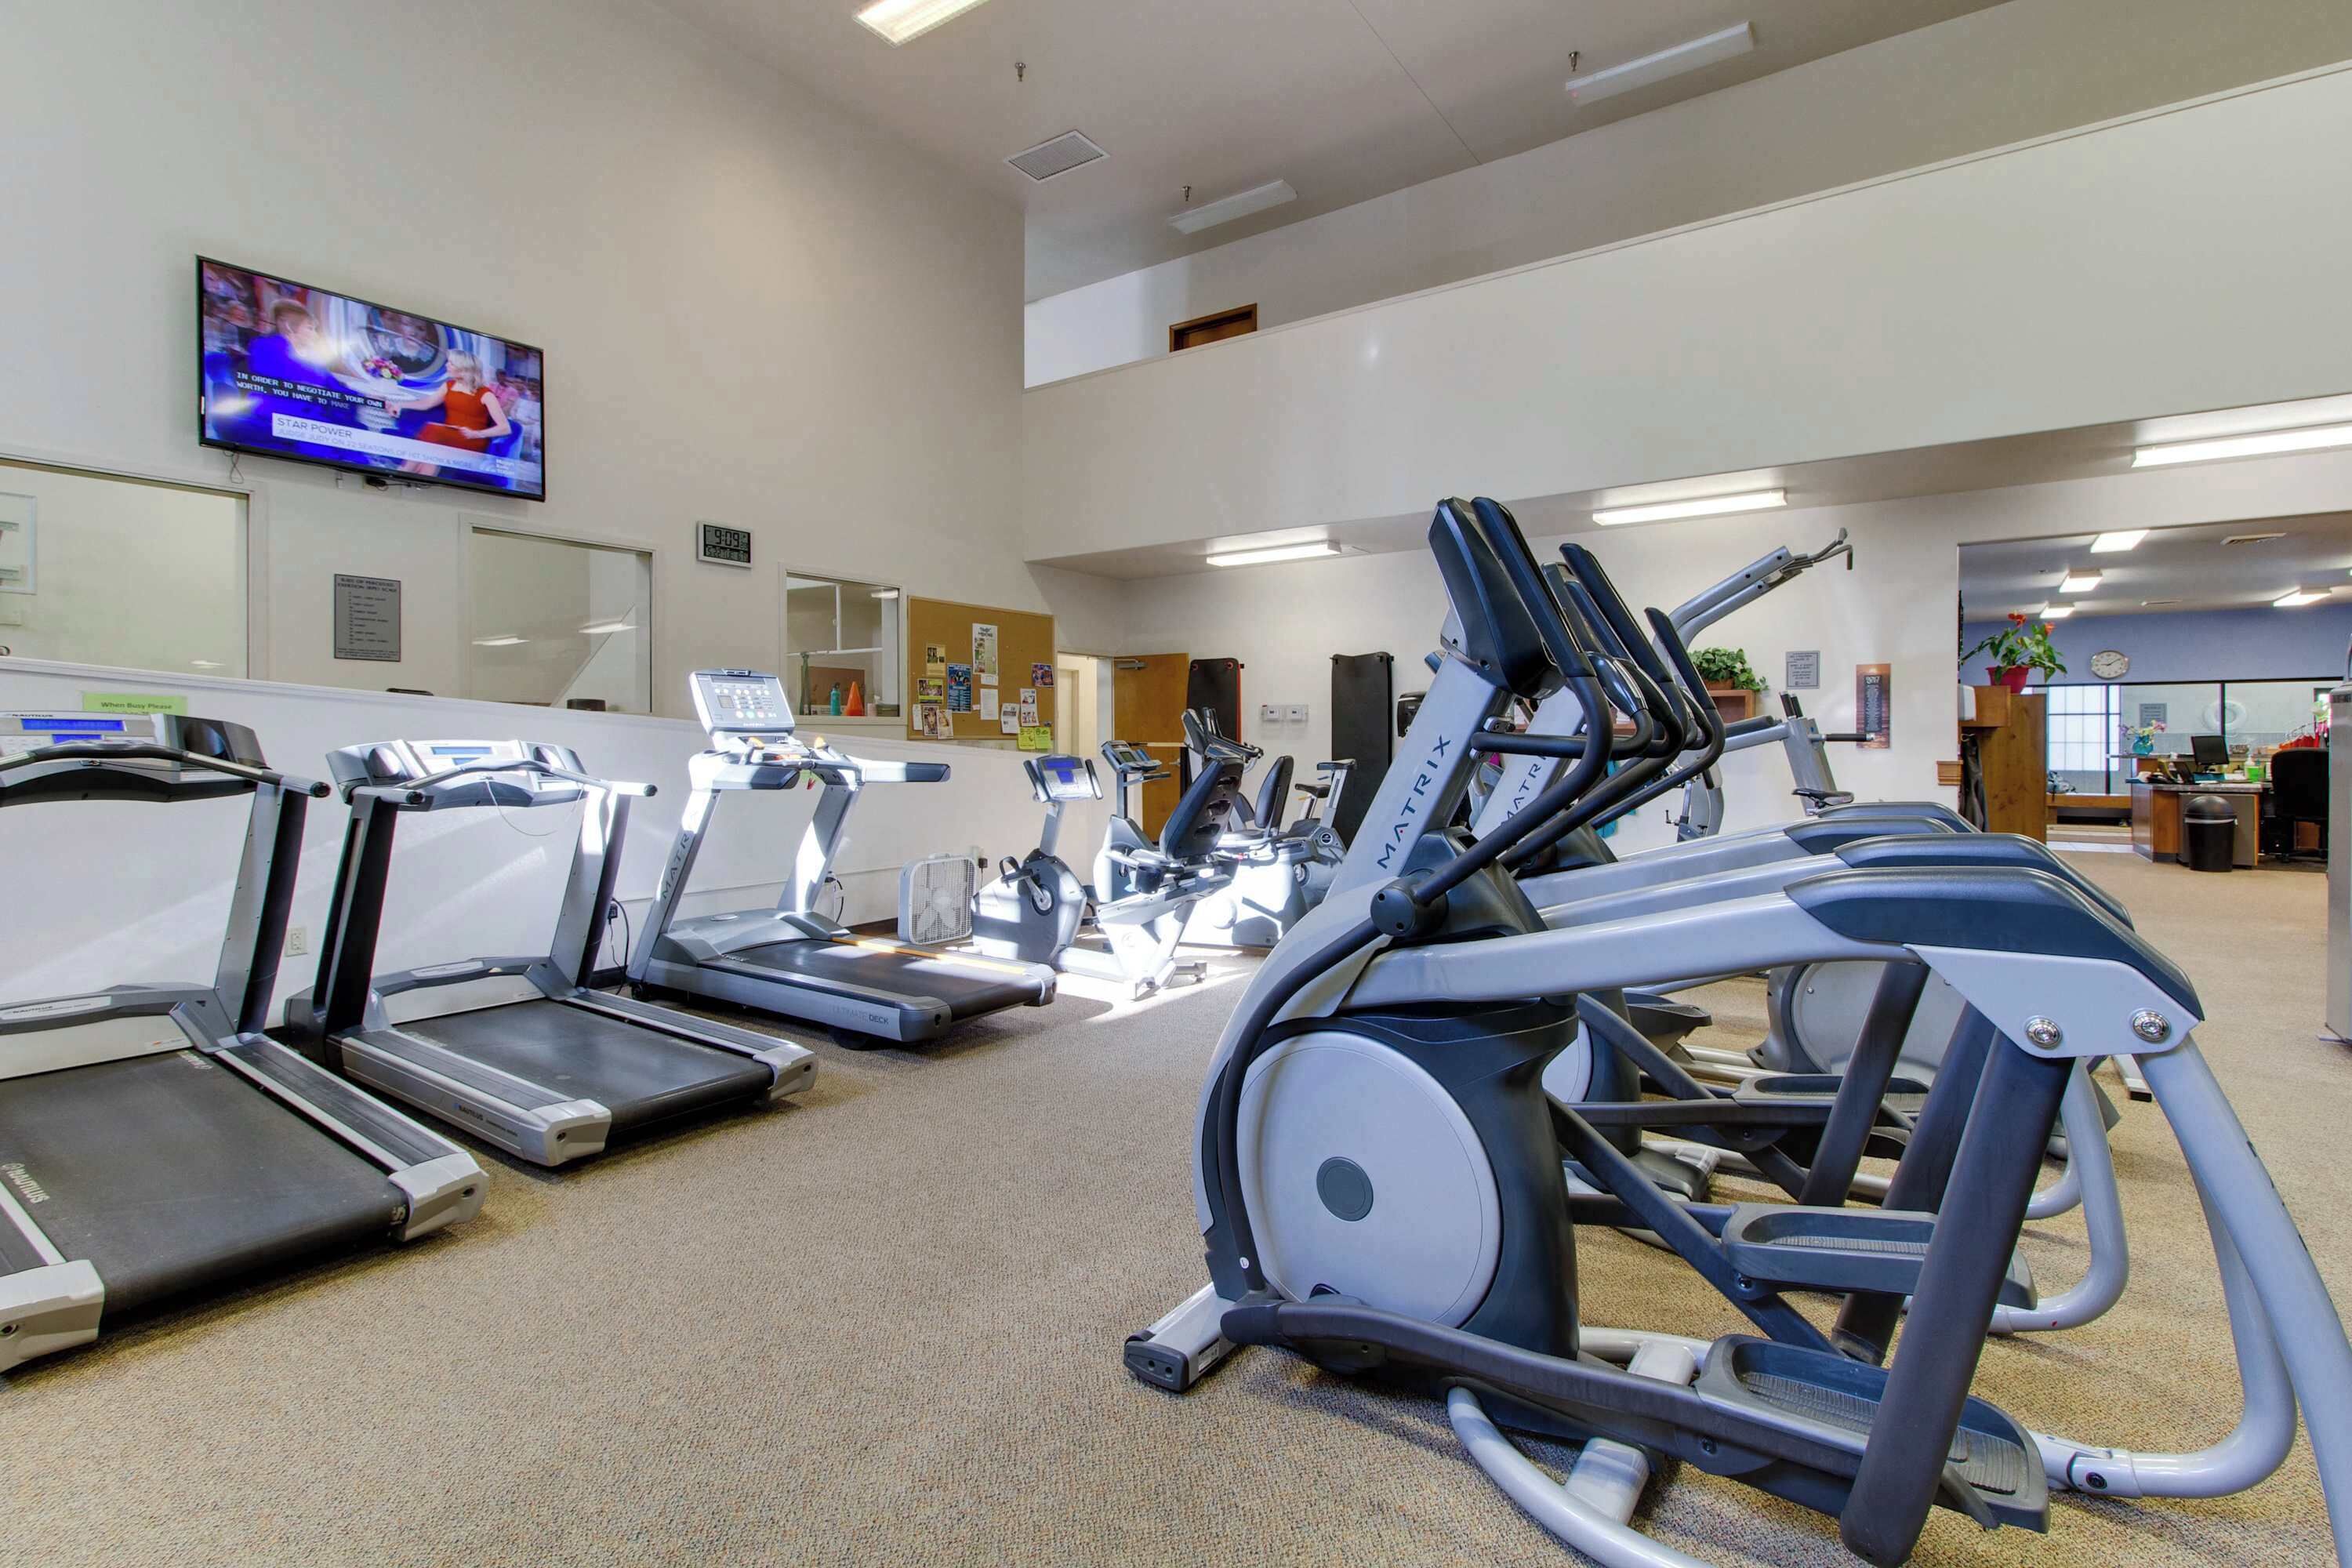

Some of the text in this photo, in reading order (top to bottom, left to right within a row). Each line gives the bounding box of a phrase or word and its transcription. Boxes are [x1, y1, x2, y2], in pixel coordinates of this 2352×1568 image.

[252, 375, 279, 387] ORDER
[283, 381, 294, 390] TO
[297, 385, 341, 400] NEGOTIATE
[345, 394, 365, 405] YOUR
[367, 399, 383, 408] OWN
[273, 388, 289, 397] YOU
[292, 393, 314, 403] HAVE
[277, 417, 352, 439] STAR POWER
[714, 528, 740, 548] 9:09
[1377, 734, 1451, 869] MATRIX
[1501, 753, 1546, 826] MATRI
[869, 1013, 890, 1025] DECK
[5, 1167, 51, 1203] NAUTILUS
